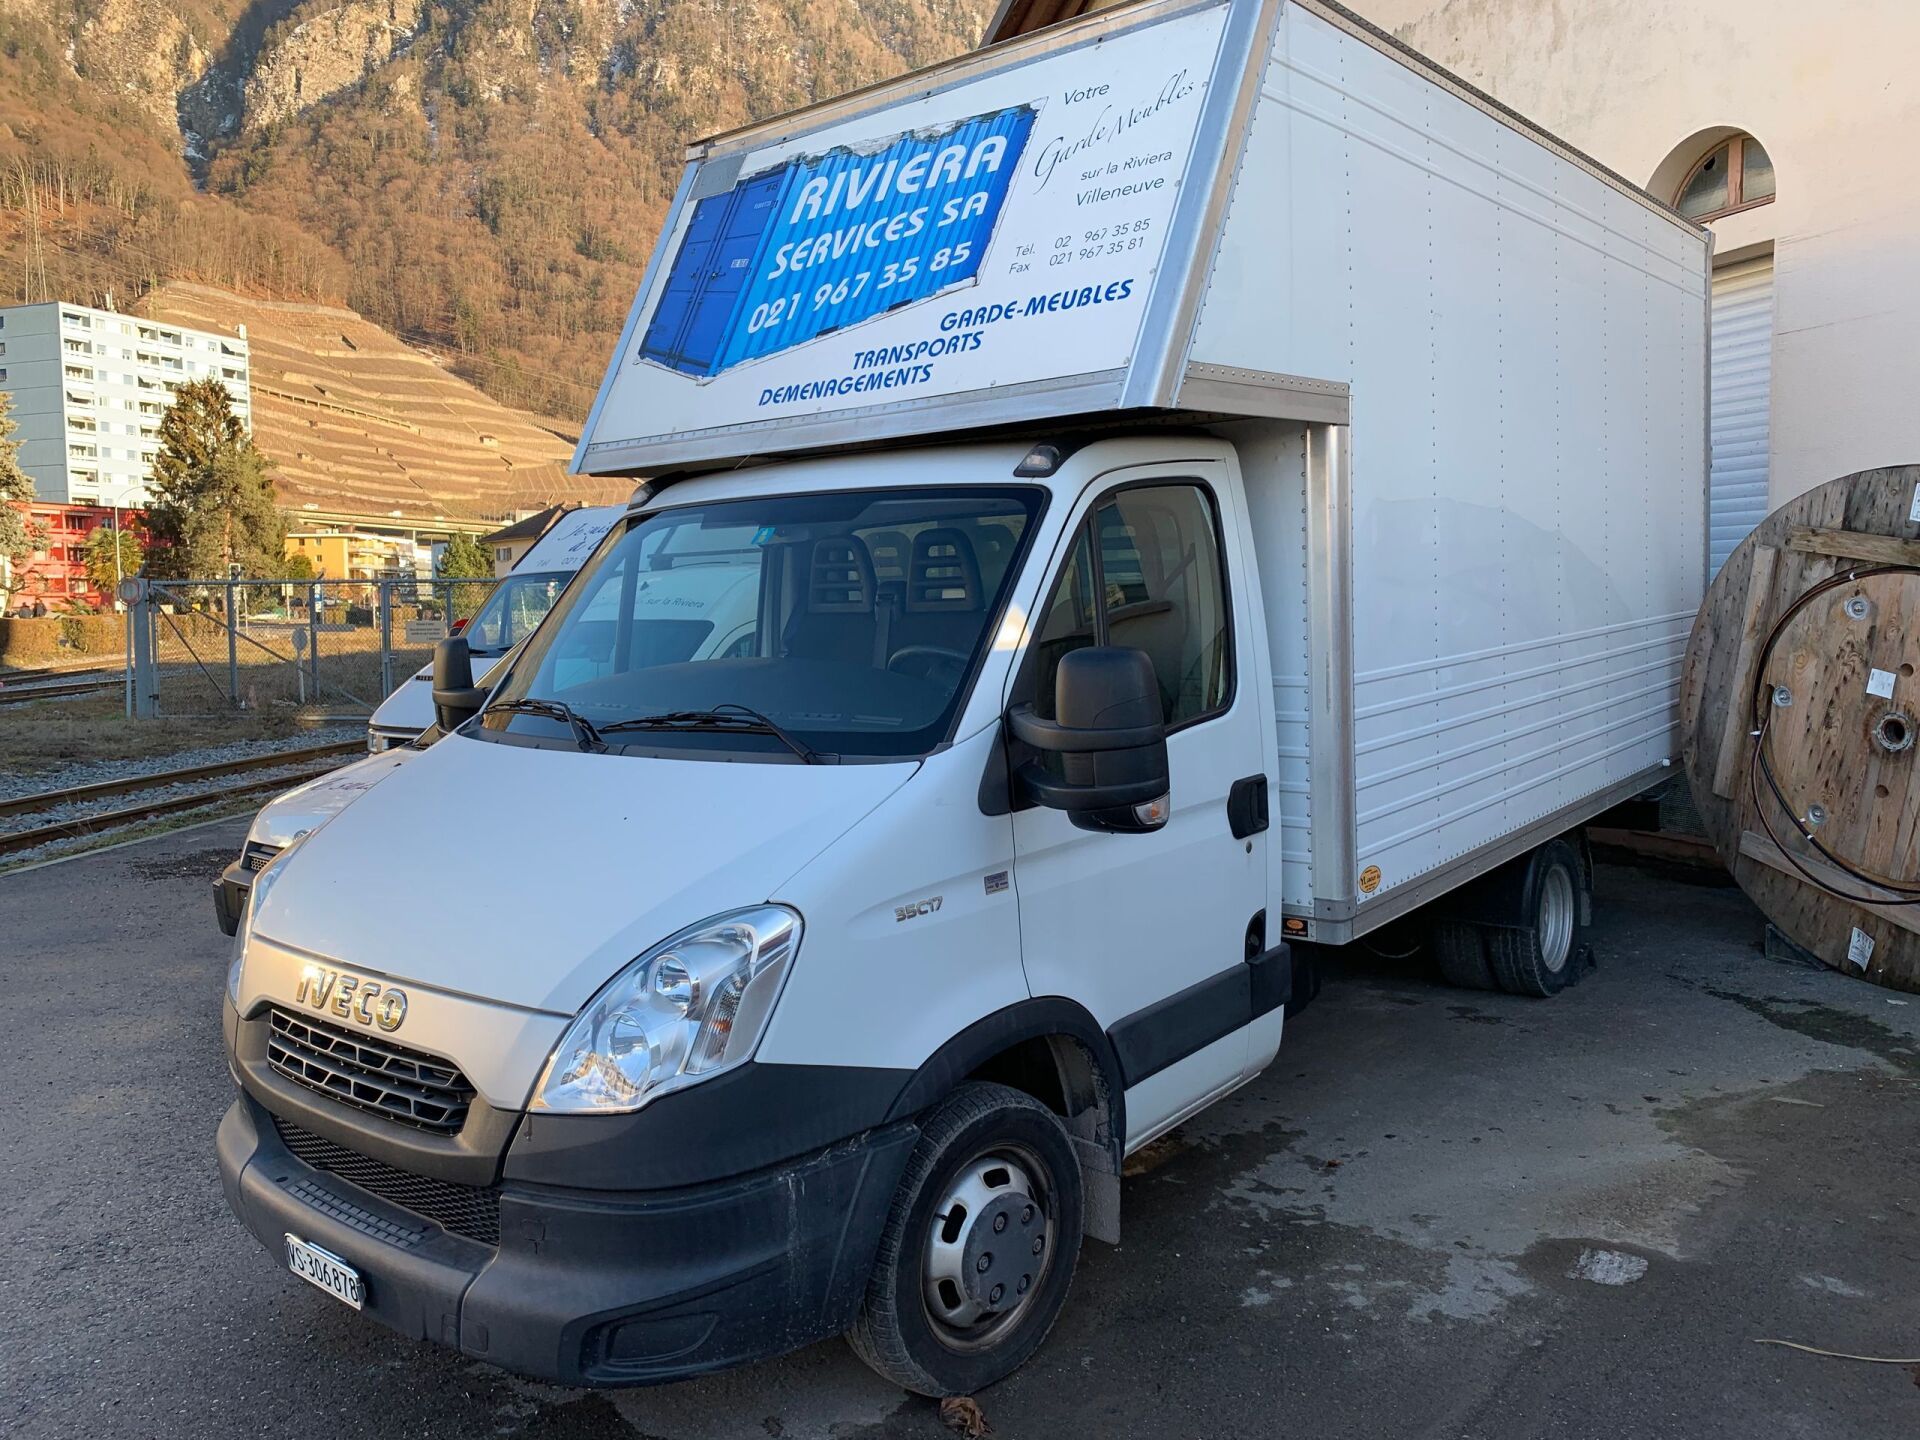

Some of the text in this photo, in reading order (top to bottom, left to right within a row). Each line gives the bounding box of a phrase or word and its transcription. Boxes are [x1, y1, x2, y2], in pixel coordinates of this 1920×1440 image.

[1064, 84, 1110, 105] Votre
[1033, 68, 1195, 196] Garde Meubles
[789, 135, 1008, 225] RIVIERA
[1080, 151, 1173, 181] sur la Riviera
[1076, 177, 1165, 207] Villeneuve
[767, 191, 989, 281] SERVICES SA
[1083, 227, 1108, 244] 967
[1111, 223, 1130, 239] 35
[1132, 218, 1151, 234] 85
[1008, 236, 1144, 275] Fax 021 967 35 81
[747, 241, 973, 334] 021 967 35 85
[940, 279, 1134, 332] GARDE-MEUBLES
[853, 331, 984, 371] TRANSPORTS
[758, 363, 934, 406] DEMENAGEMENTS
[894, 895, 943, 922] 35C17
[296, 966, 408, 1032] IVECO
